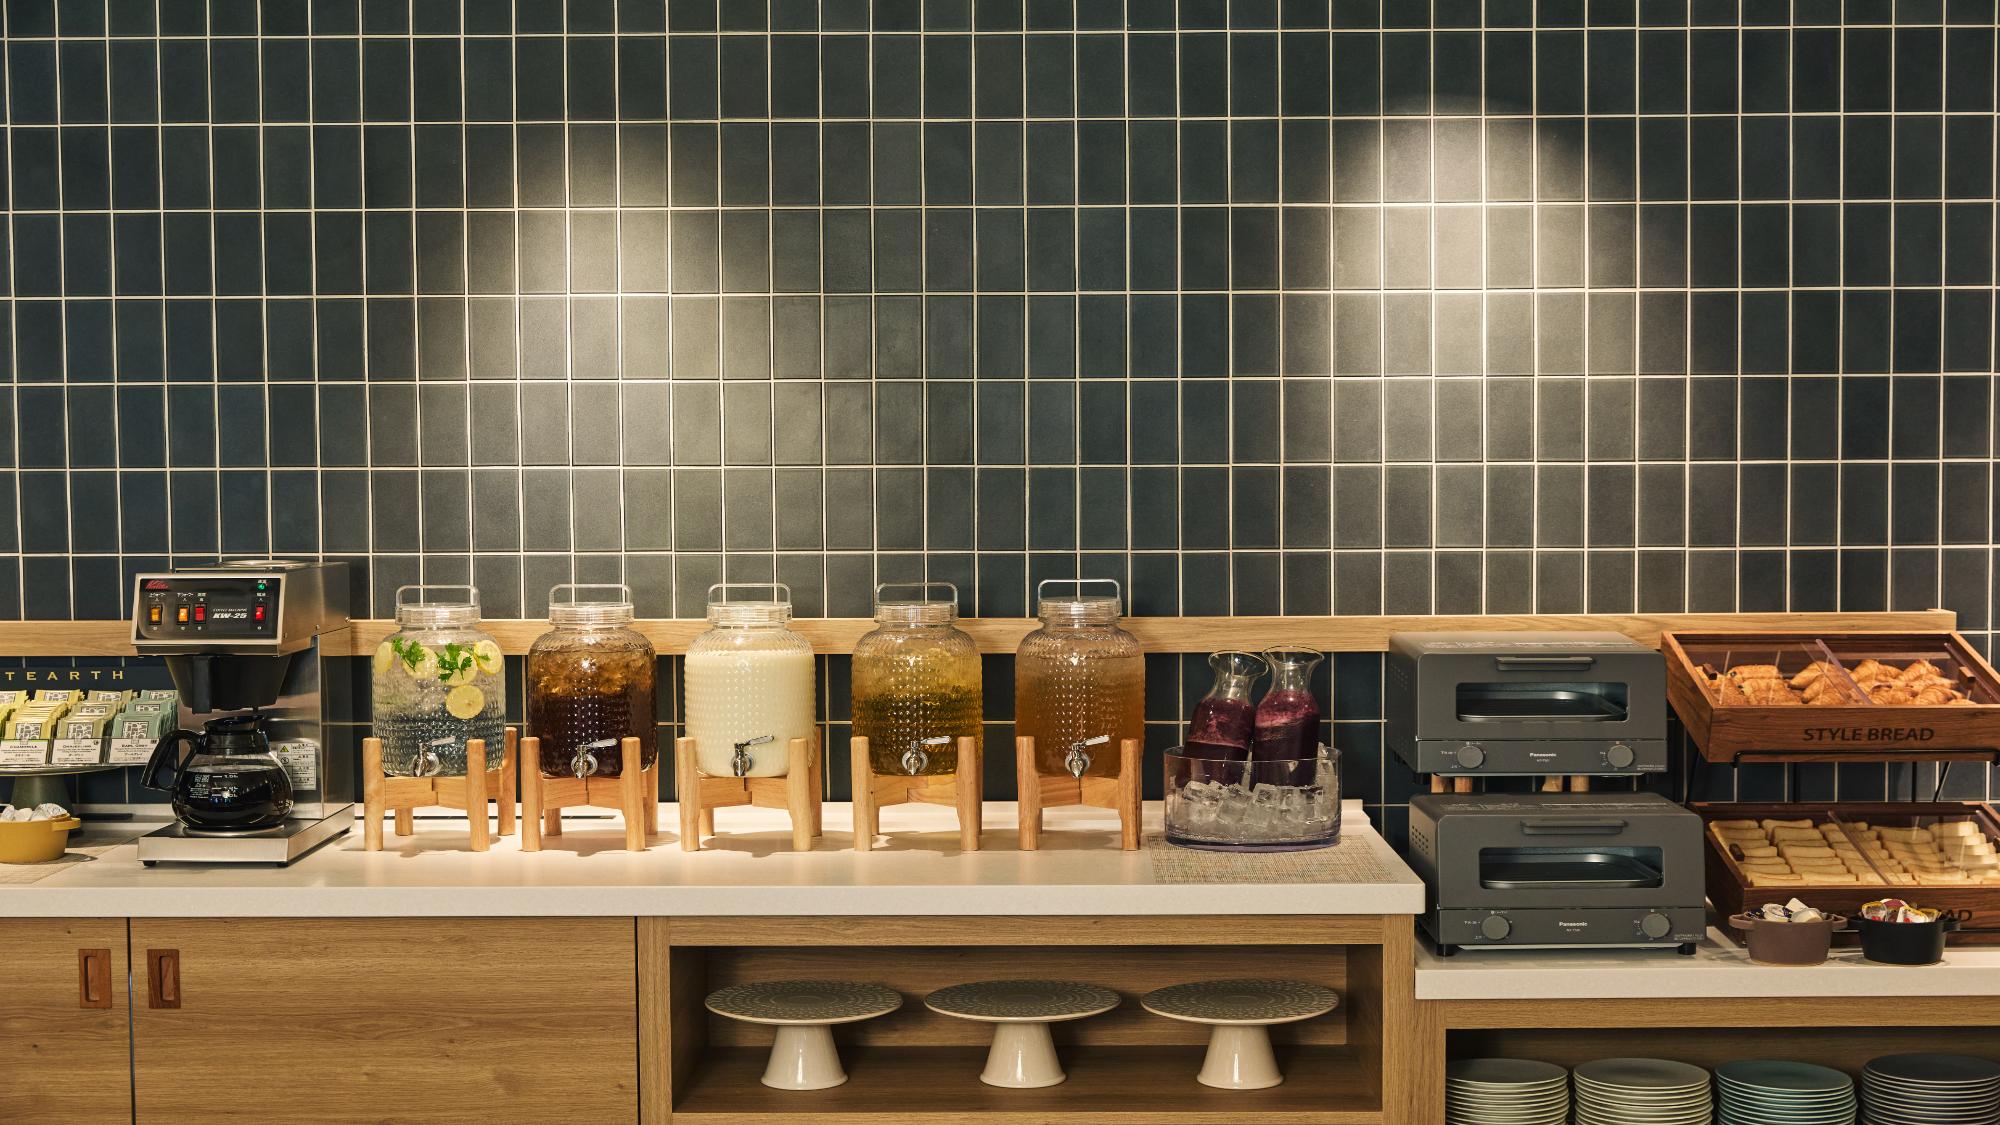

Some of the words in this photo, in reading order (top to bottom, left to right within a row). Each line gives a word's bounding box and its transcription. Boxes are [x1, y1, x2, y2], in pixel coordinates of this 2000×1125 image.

[5, 670, 125, 681] TEARTH
[1803, 727, 1863, 741] STYLE
[1867, 727, 1935, 741] BREAD
